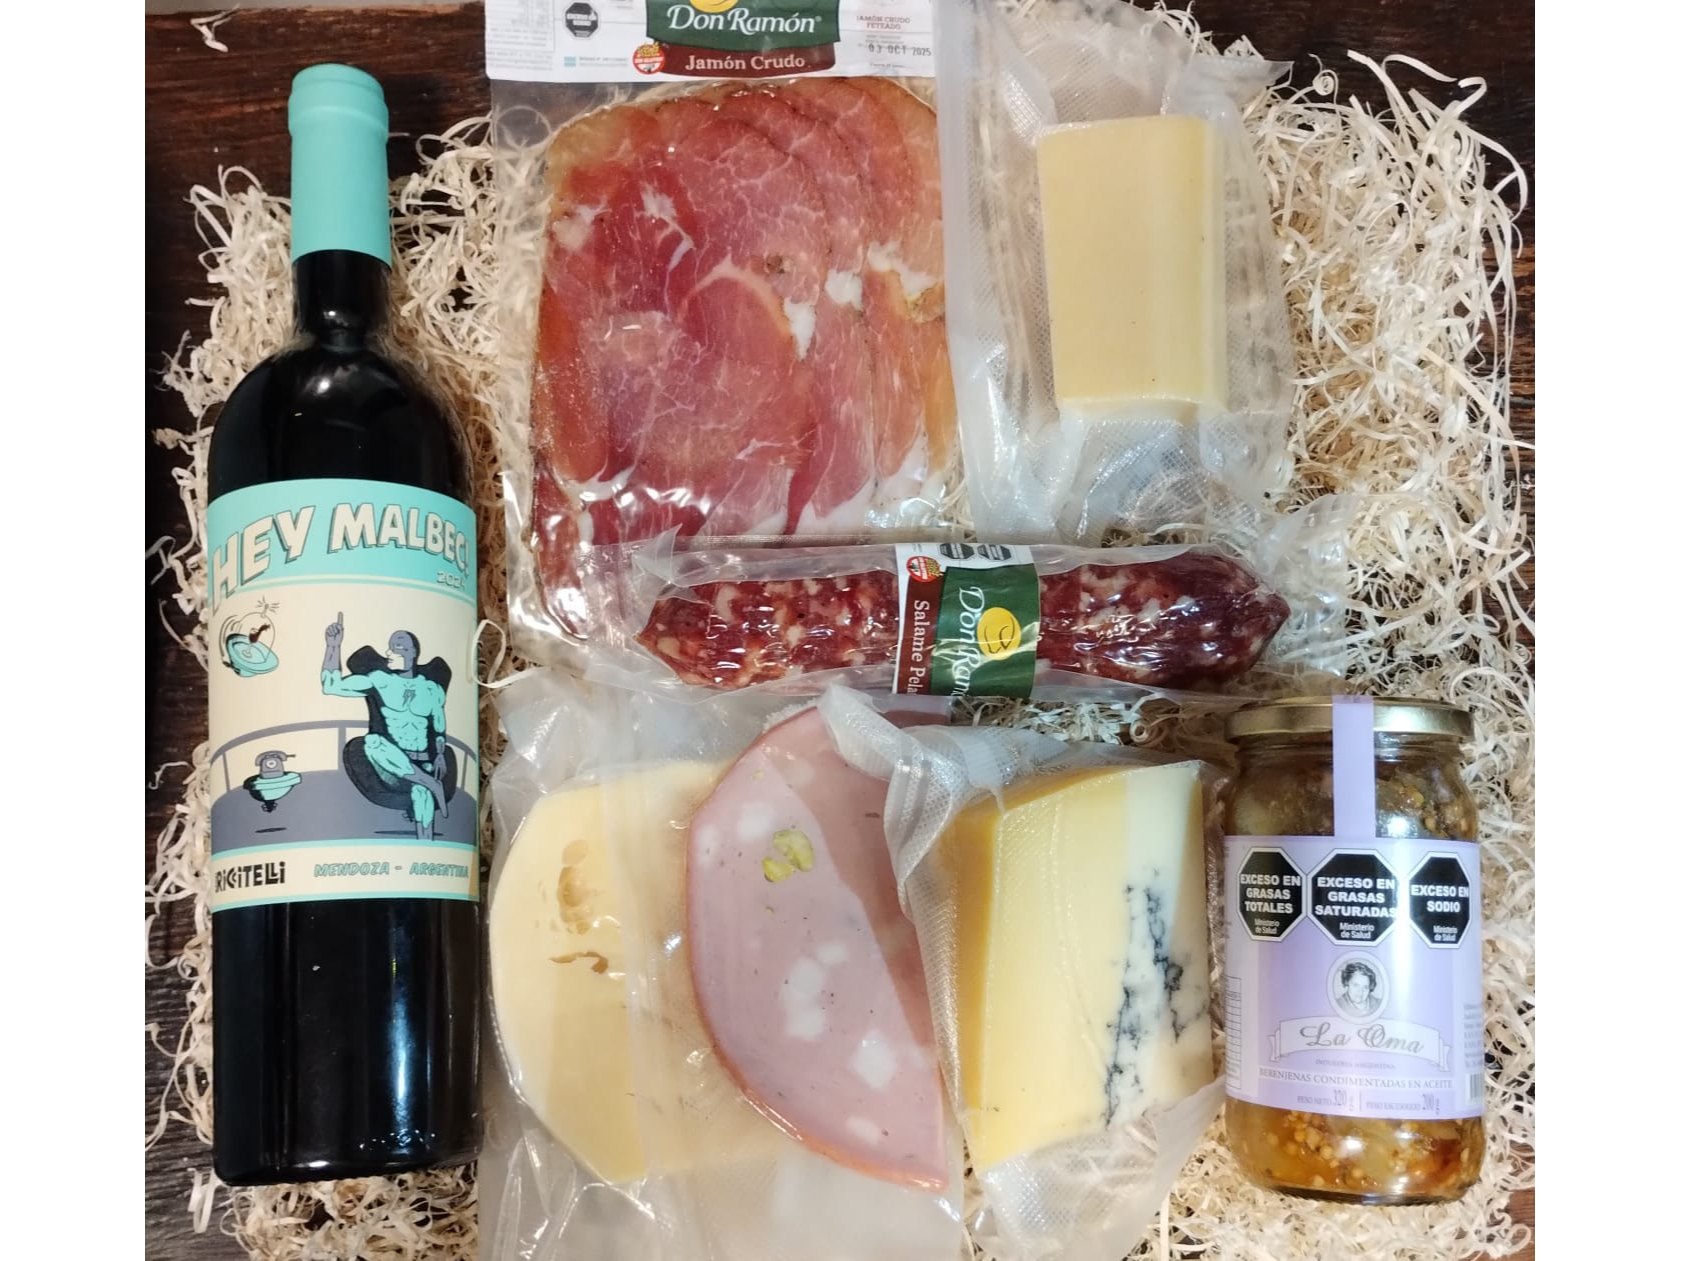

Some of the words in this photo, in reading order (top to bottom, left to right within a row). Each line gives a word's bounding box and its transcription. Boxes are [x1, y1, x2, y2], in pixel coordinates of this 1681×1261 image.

[667, 4, 724, 30] Don
[727, 8, 815, 35] Ramón
[887, 45, 907, 54] OCT
[912, 46, 932, 56] 2025
[685, 55, 746, 70] Jamón
[750, 54, 805, 70] Crudo
[212, 505, 316, 616] HEY
[327, 502, 469, 577] MALBEC!
[959, 586, 985, 644] Don
[912, 600, 931, 662] Salame
[906, 667, 926, 696] Pela
[314, 862, 390, 877] MENDOZA
[1240, 874, 1280, 886] EXCESO
[1283, 875, 1301, 886] EN
[1317, 877, 1371, 889] EXCESO
[1376, 878, 1395, 890] EN
[1246, 888, 1291, 900] GRASAS
[1327, 891, 1385, 903] GRASAS
[1410, 885, 1456, 897] EXCESO
[1458, 886, 1469, 897] EN
[1244, 900, 1293, 914] TOTALES
[1315, 905, 1397, 917] SATURADAS
[1426, 901, 1461, 912] SODIO
[1339, 922, 1375, 932] Ministerio
[1351, 930, 1372, 939] Salud
[1299, 1022, 1351, 1047] La
[1357, 1024, 1424, 1053] Oma
[1259, 1068, 1311, 1082] BERENJENAS
[1313, 1075, 1406, 1089] CONDIMENTADAS
[1408, 1080, 1422, 1088] EN
[1423, 1080, 1453, 1089] ACEITE
